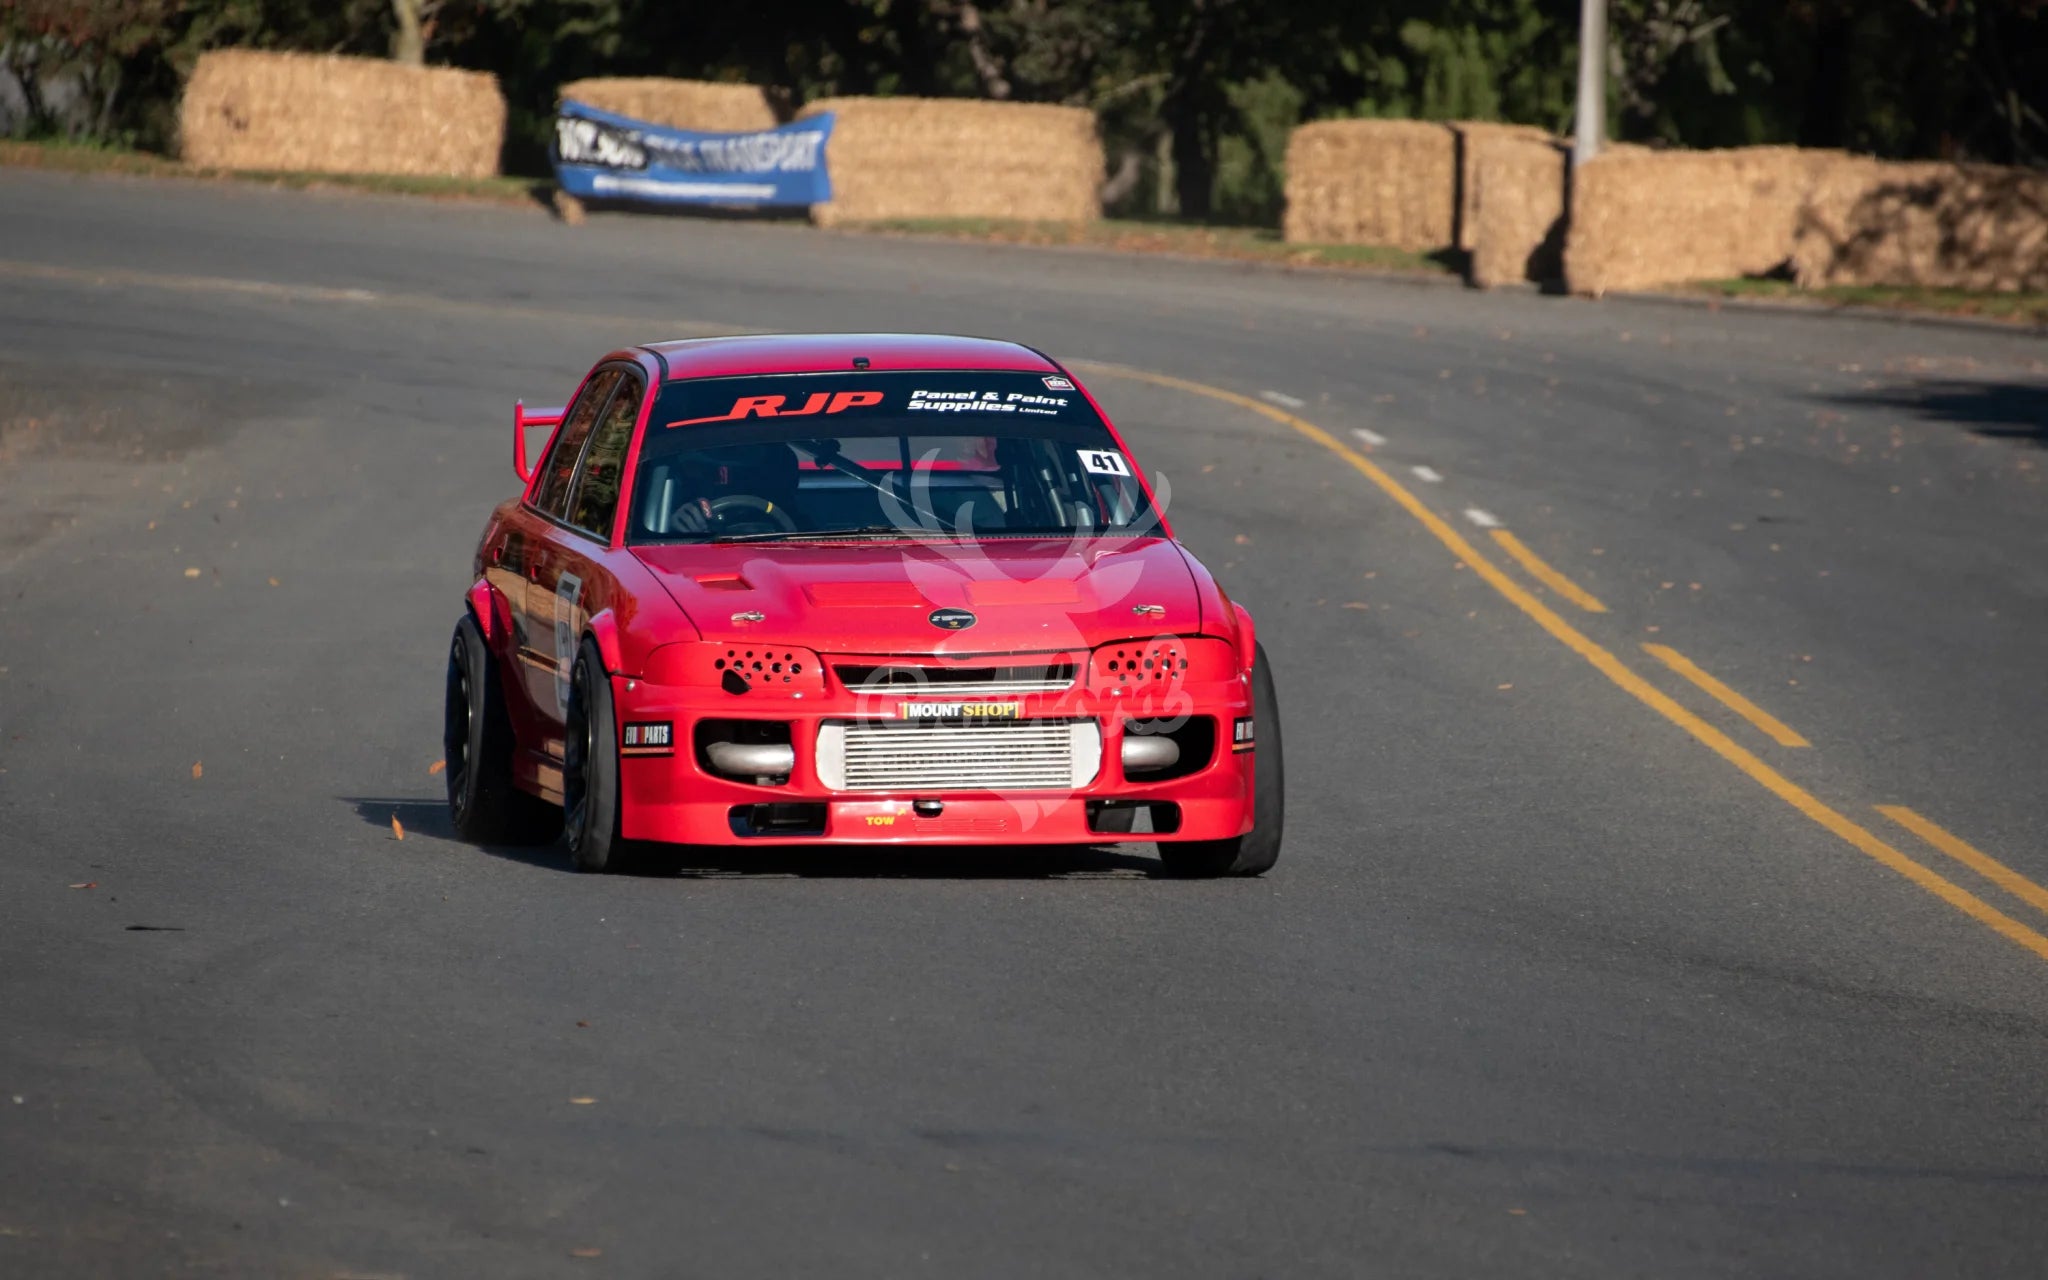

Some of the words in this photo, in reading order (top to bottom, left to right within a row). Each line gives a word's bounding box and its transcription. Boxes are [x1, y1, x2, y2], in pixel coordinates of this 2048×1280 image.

[911, 390, 977, 400] Panel
[982, 392, 999, 400] &
[1006, 393, 1068, 407] Paint
[666, 391, 884, 428] RJP
[907, 400, 1017, 412] Supplies
[1019, 407, 1058, 415] Limited
[1092, 454, 1120, 471] 41
[909, 703, 961, 717] MOUNT
[963, 703, 1015, 717] SHOP
[865, 816, 895, 826] TOW
